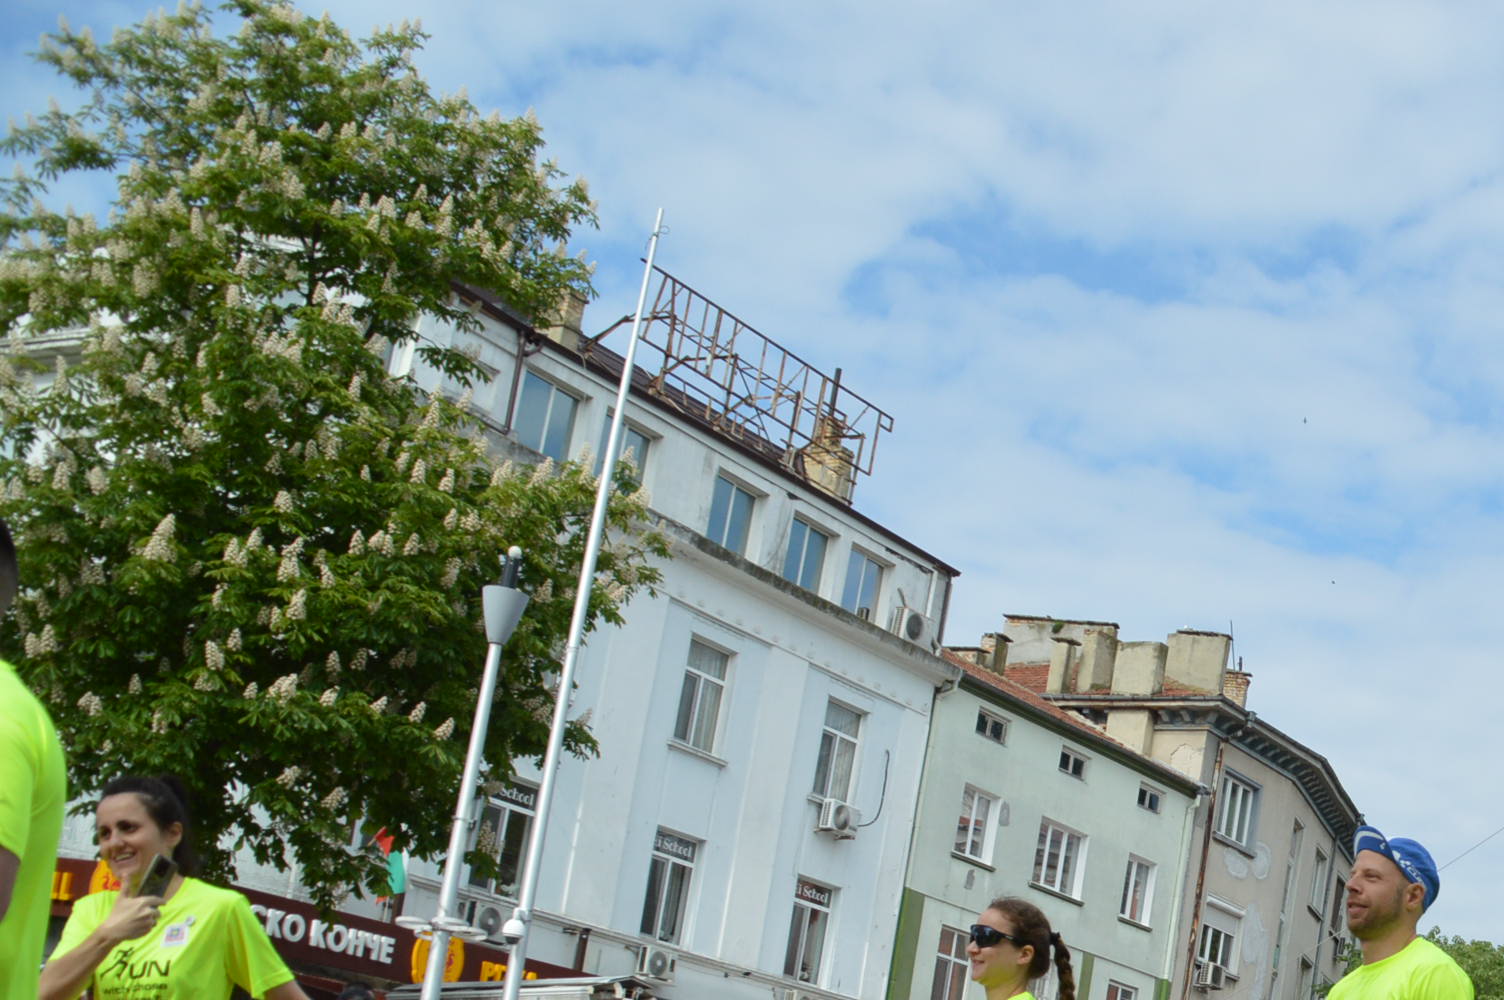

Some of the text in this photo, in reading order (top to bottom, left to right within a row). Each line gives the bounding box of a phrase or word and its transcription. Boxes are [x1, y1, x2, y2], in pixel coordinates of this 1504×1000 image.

[663, 837, 693, 858] School
[803, 884, 830, 905] School
[309, 918, 397, 964] КОНЧЕ
